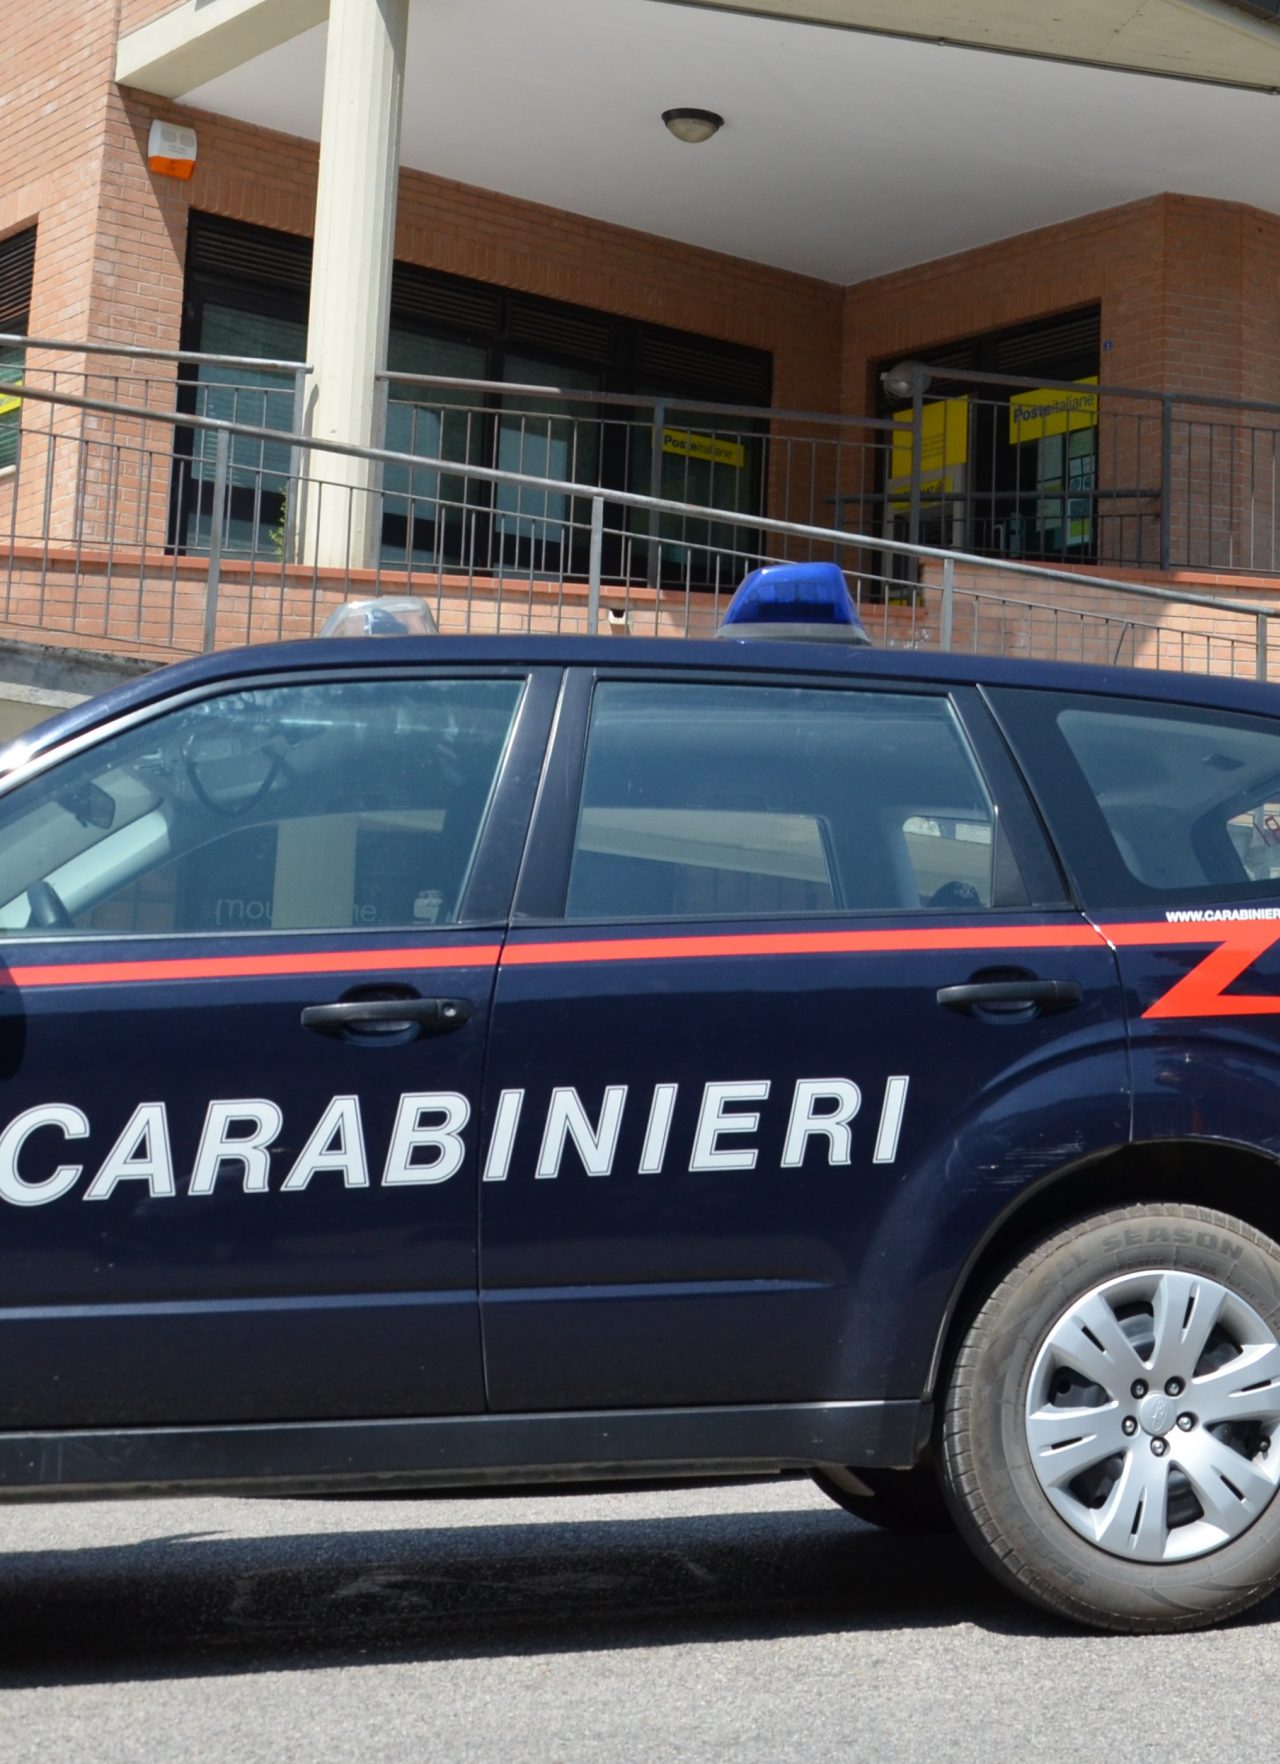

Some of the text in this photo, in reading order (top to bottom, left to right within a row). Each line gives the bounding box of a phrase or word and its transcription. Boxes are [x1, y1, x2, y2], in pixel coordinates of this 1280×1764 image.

[664, 435, 733, 459] Poseitalane
[0, 1075, 910, 1207] CARABINIERI
[1102, 1226, 1244, 1261] SEASON
